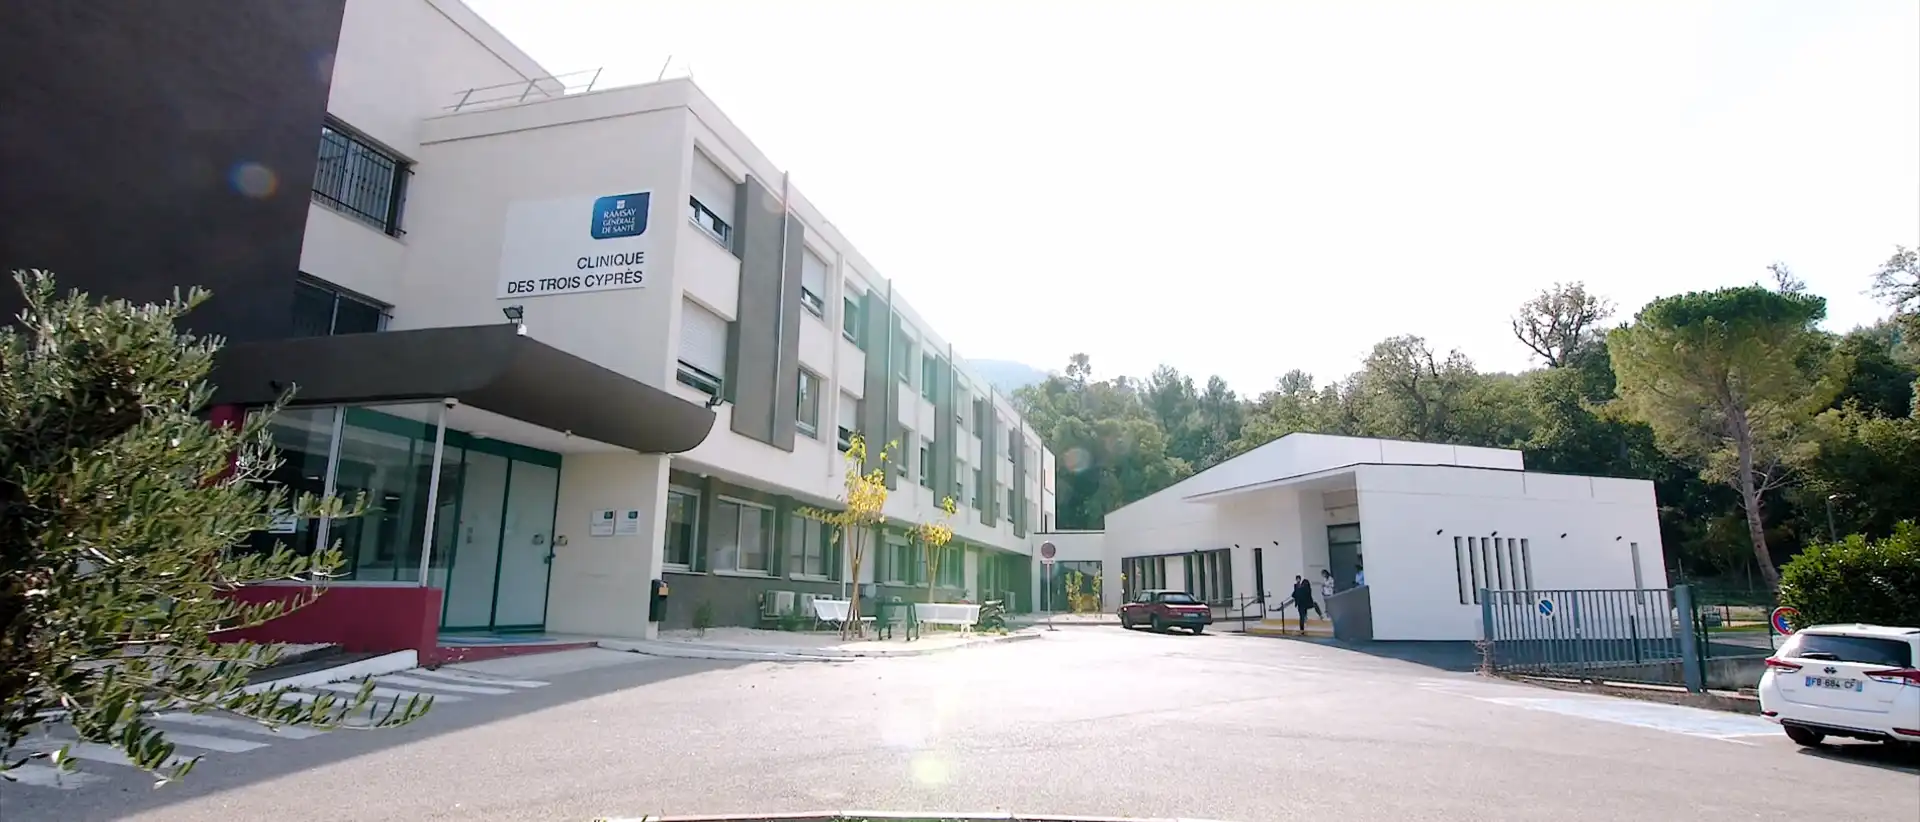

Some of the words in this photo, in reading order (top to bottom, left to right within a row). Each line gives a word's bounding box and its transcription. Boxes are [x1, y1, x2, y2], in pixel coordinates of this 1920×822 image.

[603, 208, 637, 219] RAMSAY
[601, 226, 611, 234] DE
[576, 251, 645, 270] CLINIQUE
[507, 280, 535, 294] DES
[539, 276, 581, 291] TROIS
[584, 268, 644, 288] CYPRÈS
